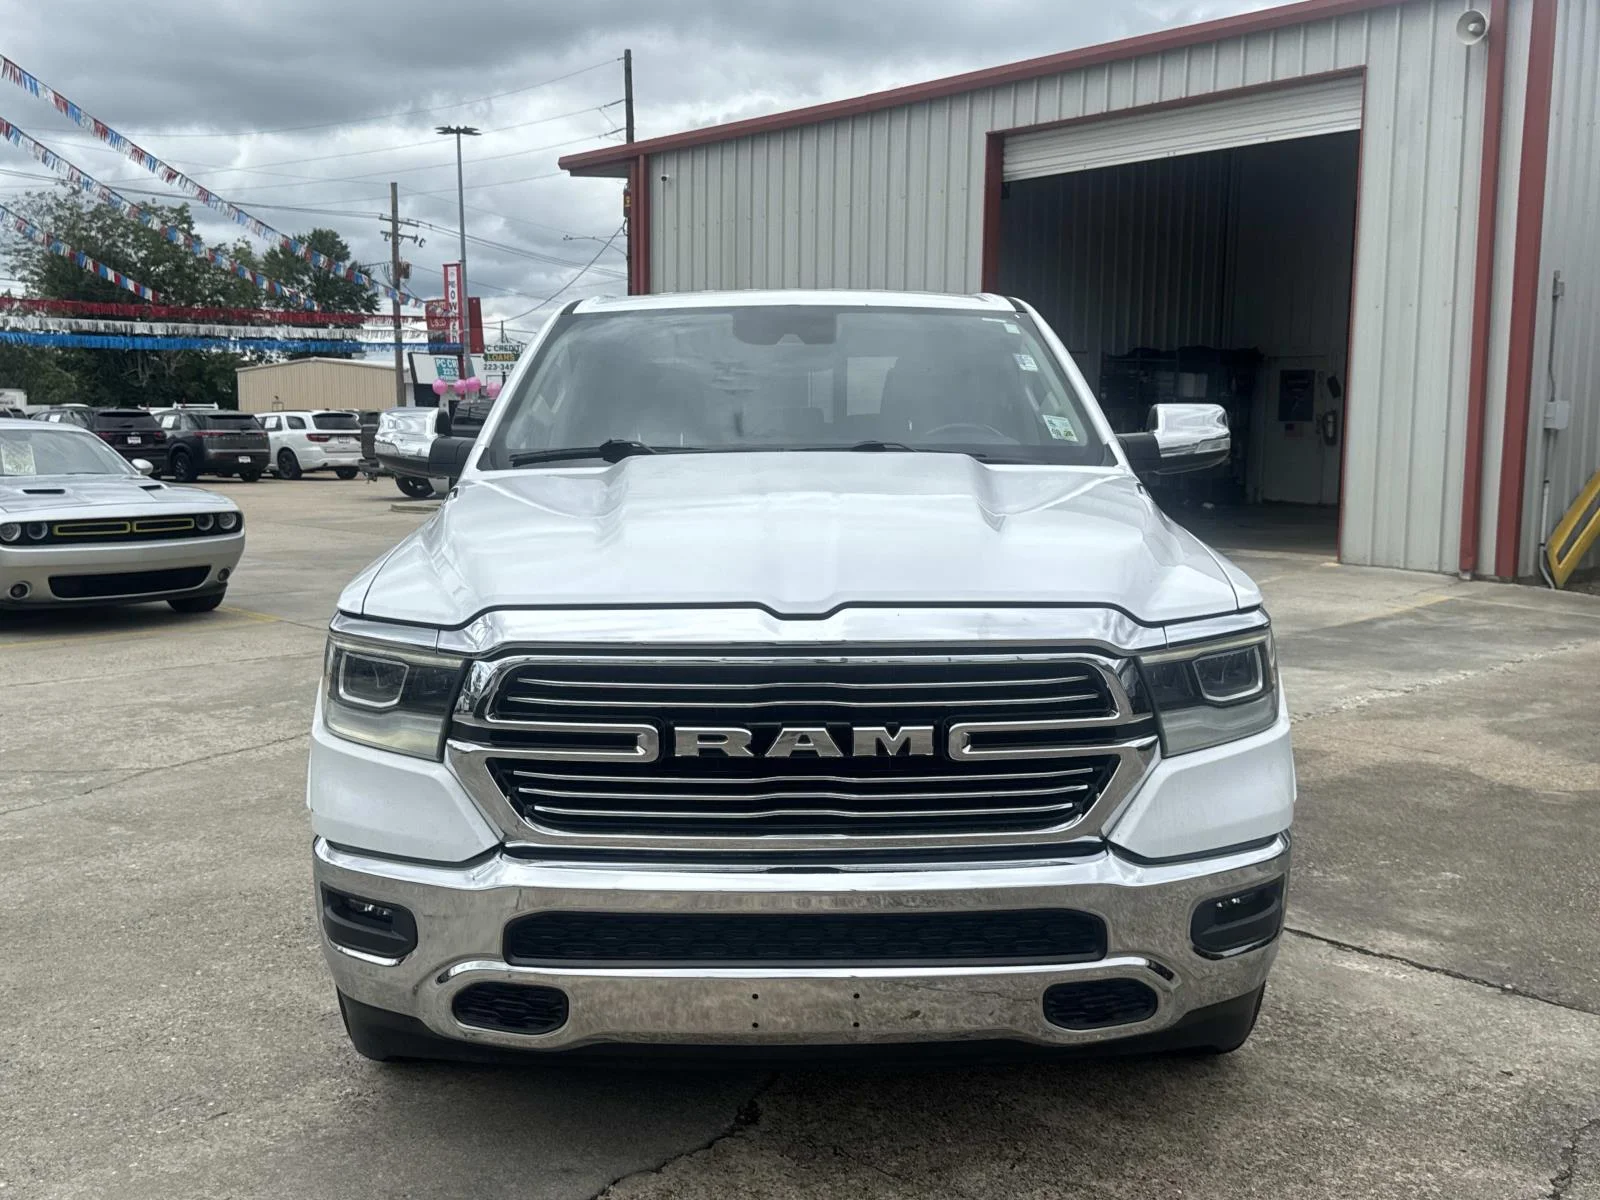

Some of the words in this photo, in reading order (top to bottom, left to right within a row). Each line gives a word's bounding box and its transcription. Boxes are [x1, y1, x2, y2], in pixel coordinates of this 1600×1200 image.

[494, 344, 520, 352] CREDIT
[487, 353, 515, 361] LOANS
[674, 726, 935, 758] RAM
